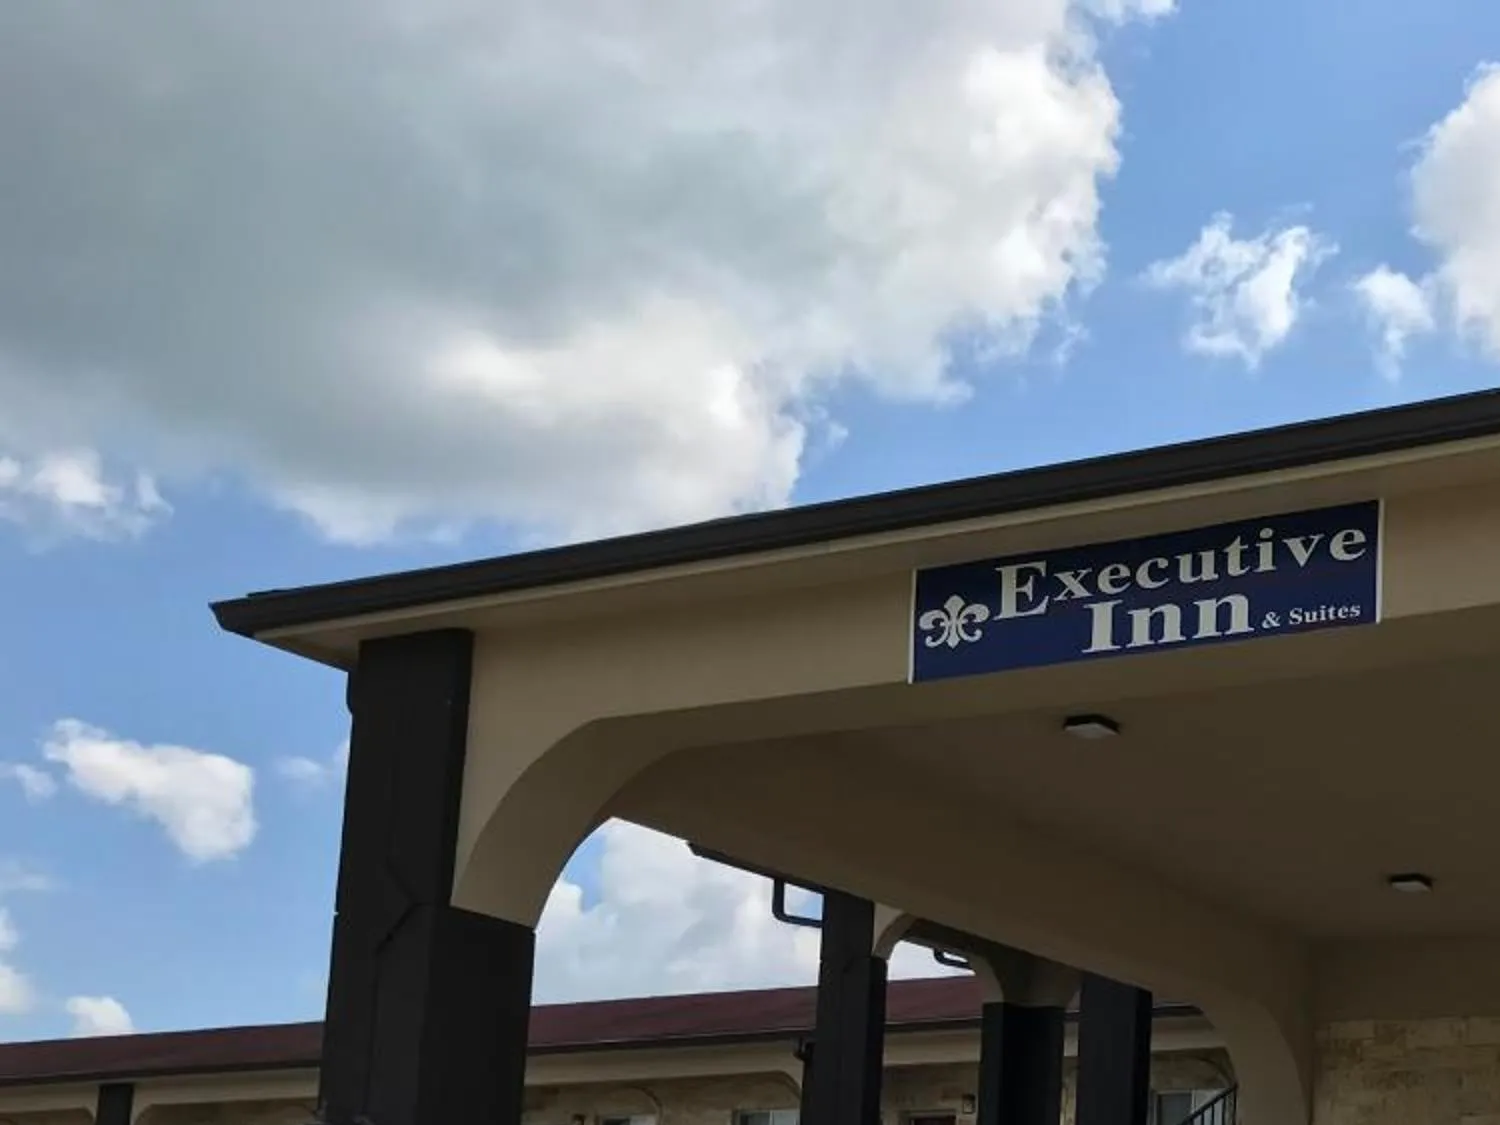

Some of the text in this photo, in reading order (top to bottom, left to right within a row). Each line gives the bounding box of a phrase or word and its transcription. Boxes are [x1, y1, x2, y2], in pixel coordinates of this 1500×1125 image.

[993, 527, 1367, 621] Executive
[1082, 592, 1362, 653] Inn & Suites
